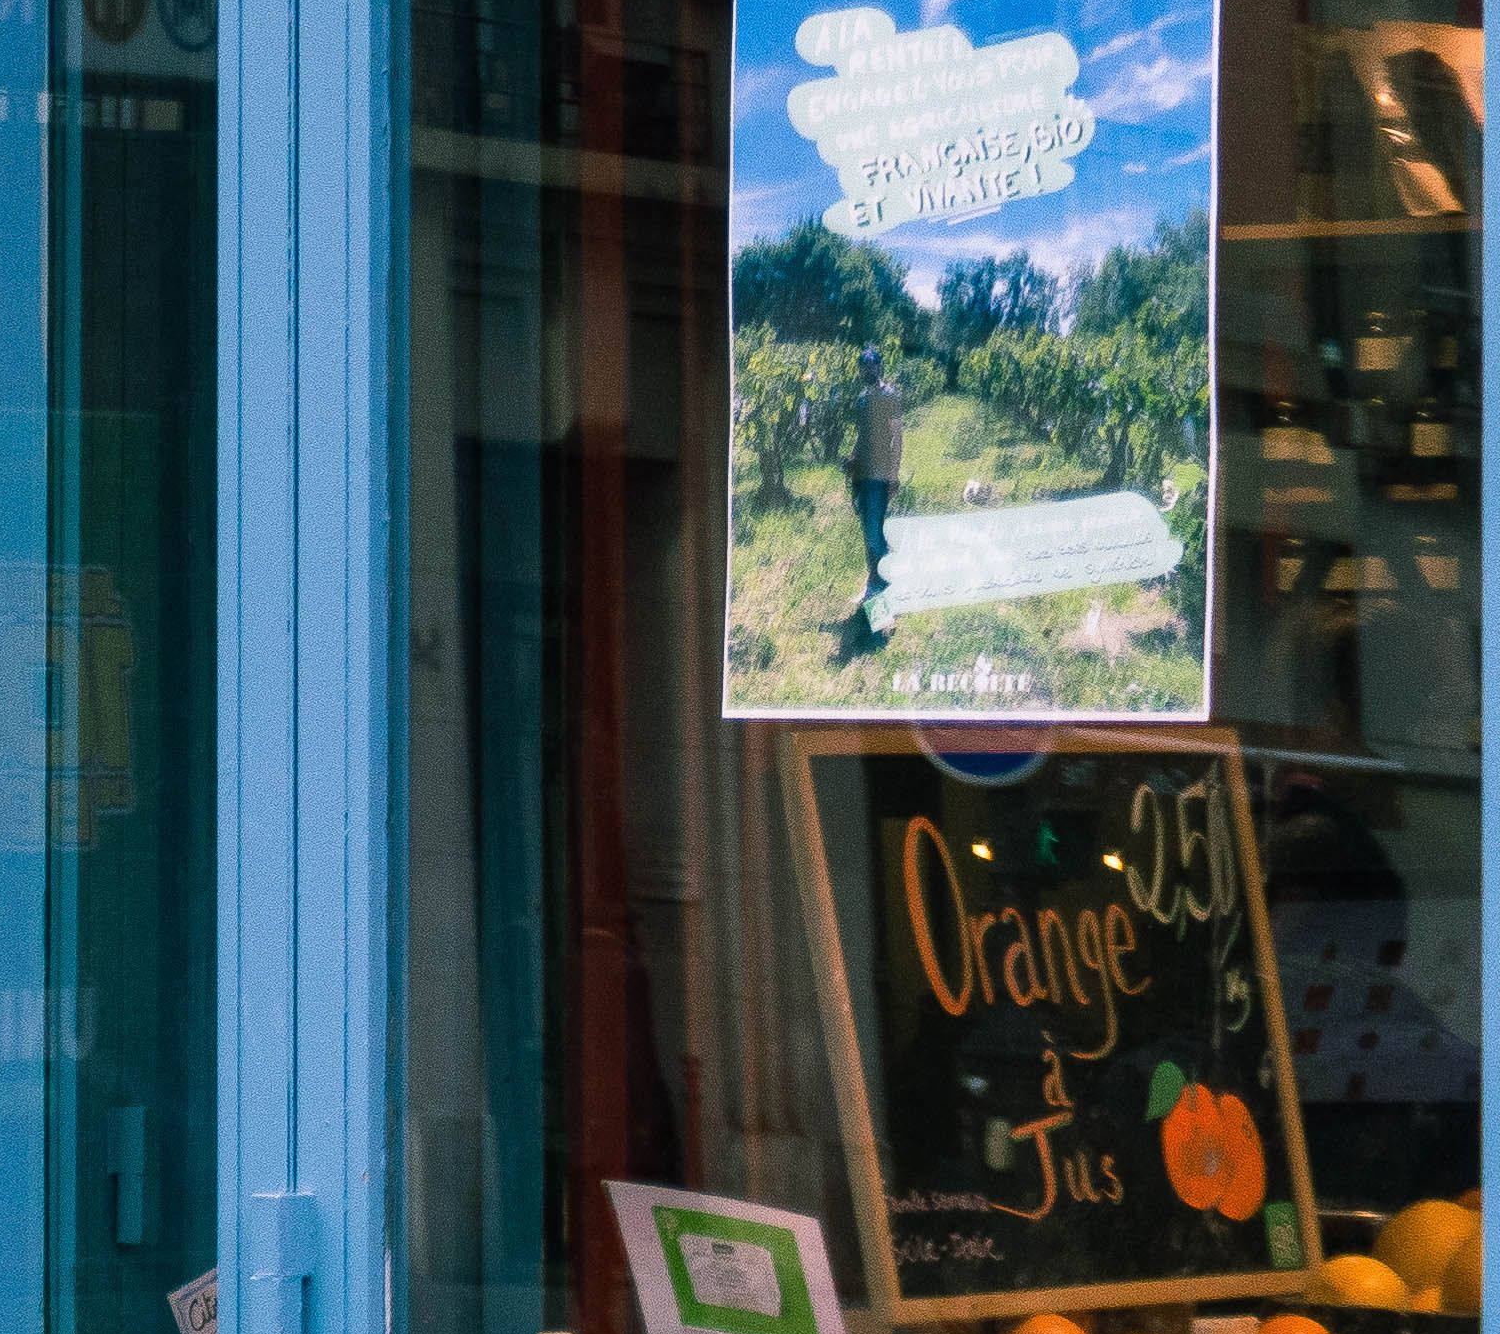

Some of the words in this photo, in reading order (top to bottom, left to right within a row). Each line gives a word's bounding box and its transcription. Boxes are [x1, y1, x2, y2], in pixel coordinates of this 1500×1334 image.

[849, 195, 888, 228] ET
[904, 815, 1152, 1060] Orange
[1042, 1029, 1075, 1108] à
[991, 1111, 1125, 1220] Jus
